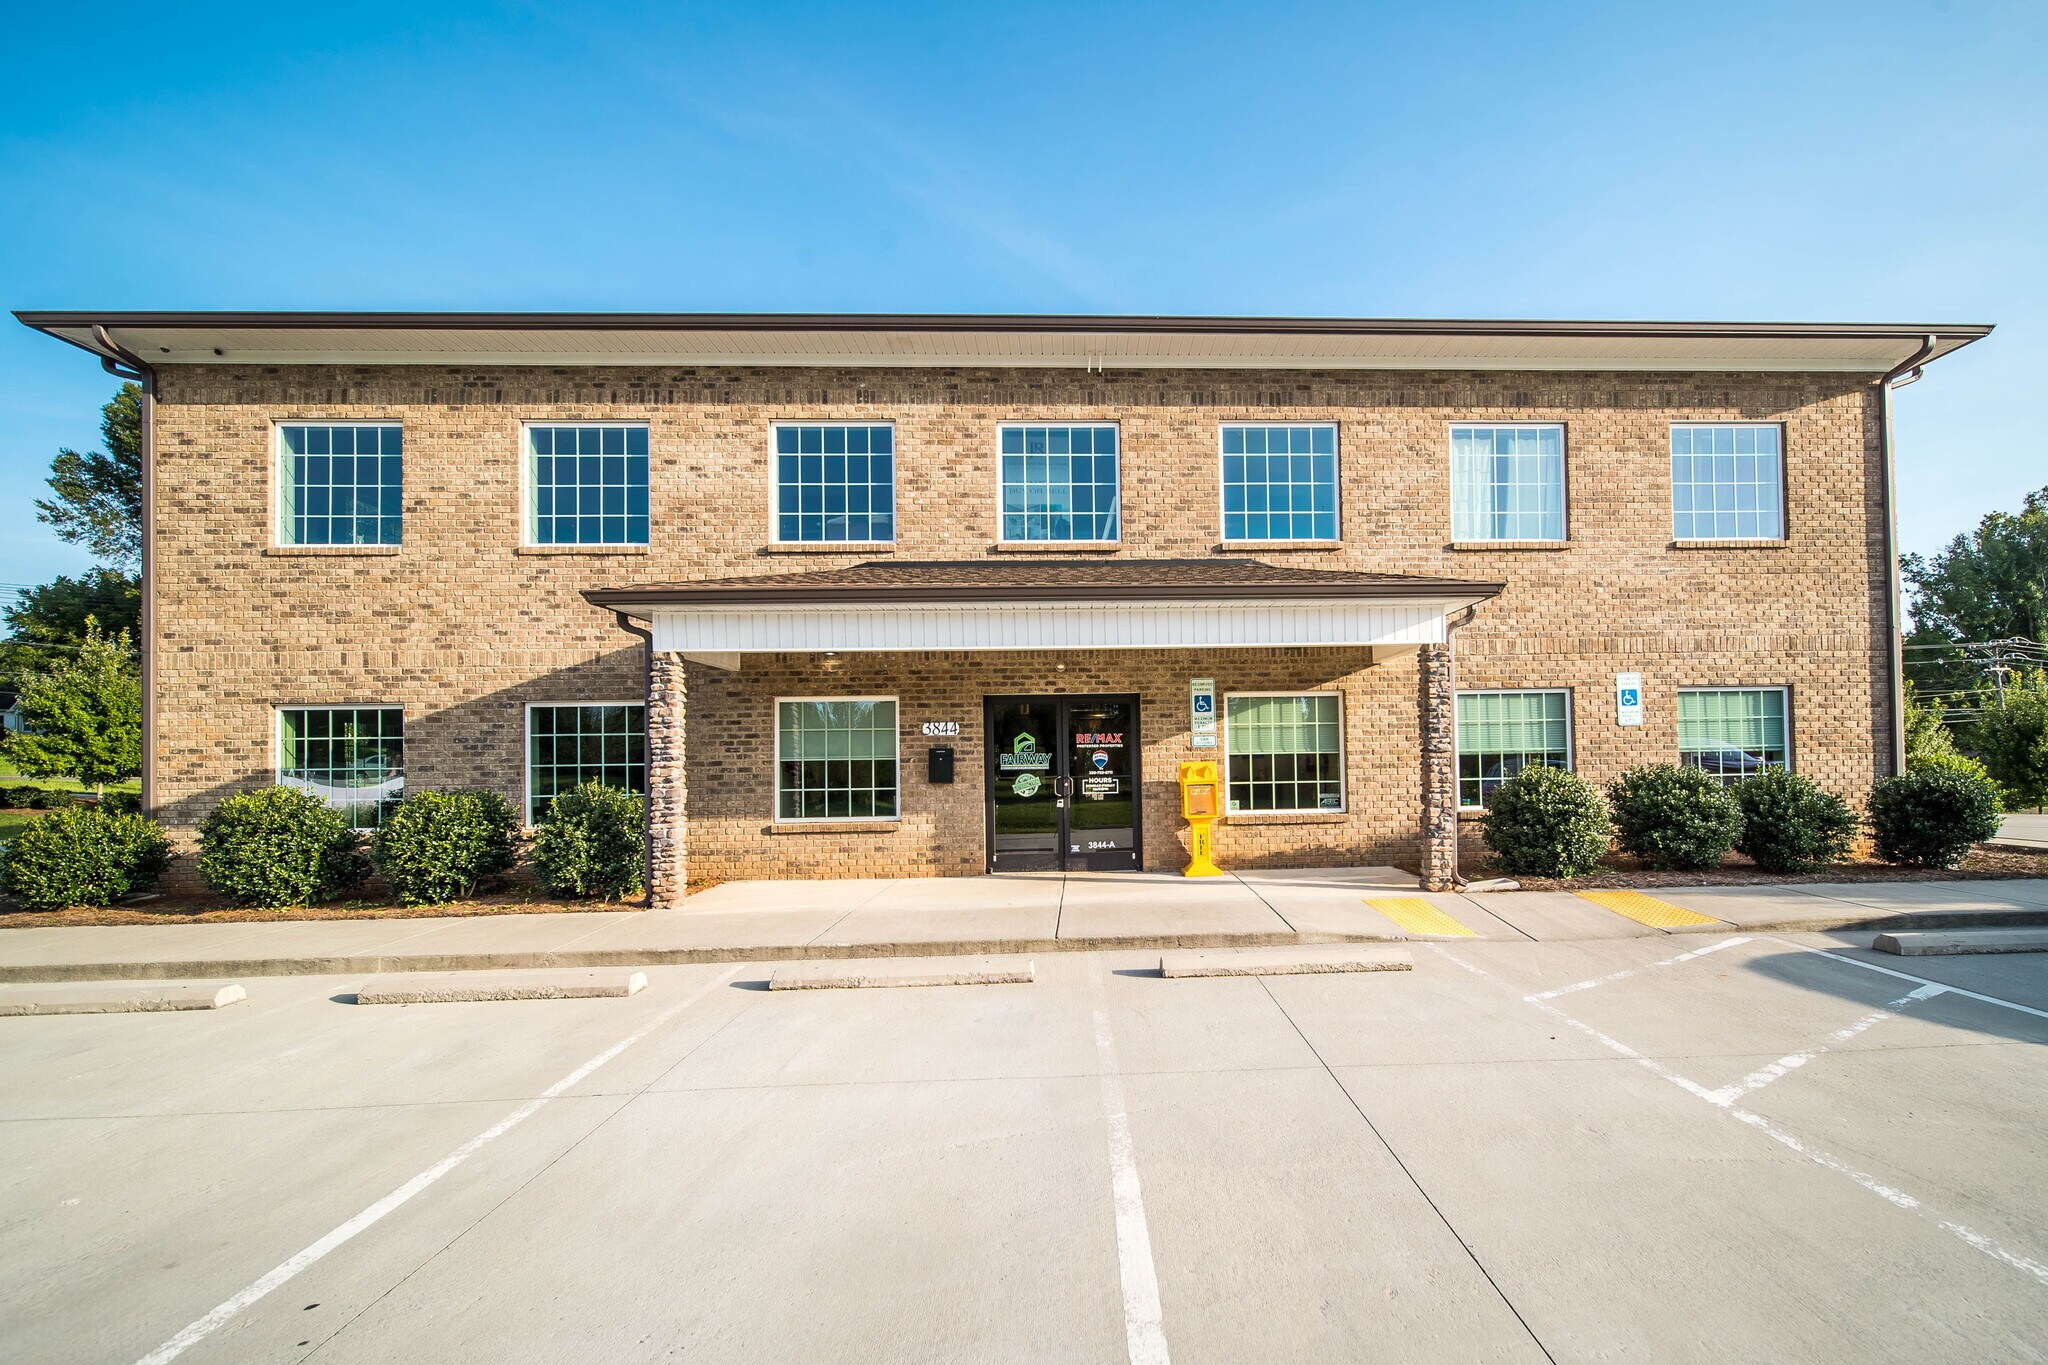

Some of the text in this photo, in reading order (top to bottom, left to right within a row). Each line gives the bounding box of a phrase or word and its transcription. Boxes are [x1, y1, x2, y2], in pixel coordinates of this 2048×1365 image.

[922, 720, 958, 736] 3844
[1076, 733, 1123, 743] RE/MAX
[1000, 753, 1052, 765] FAIRWAY
[1088, 840, 1115, 849] 3844-A
